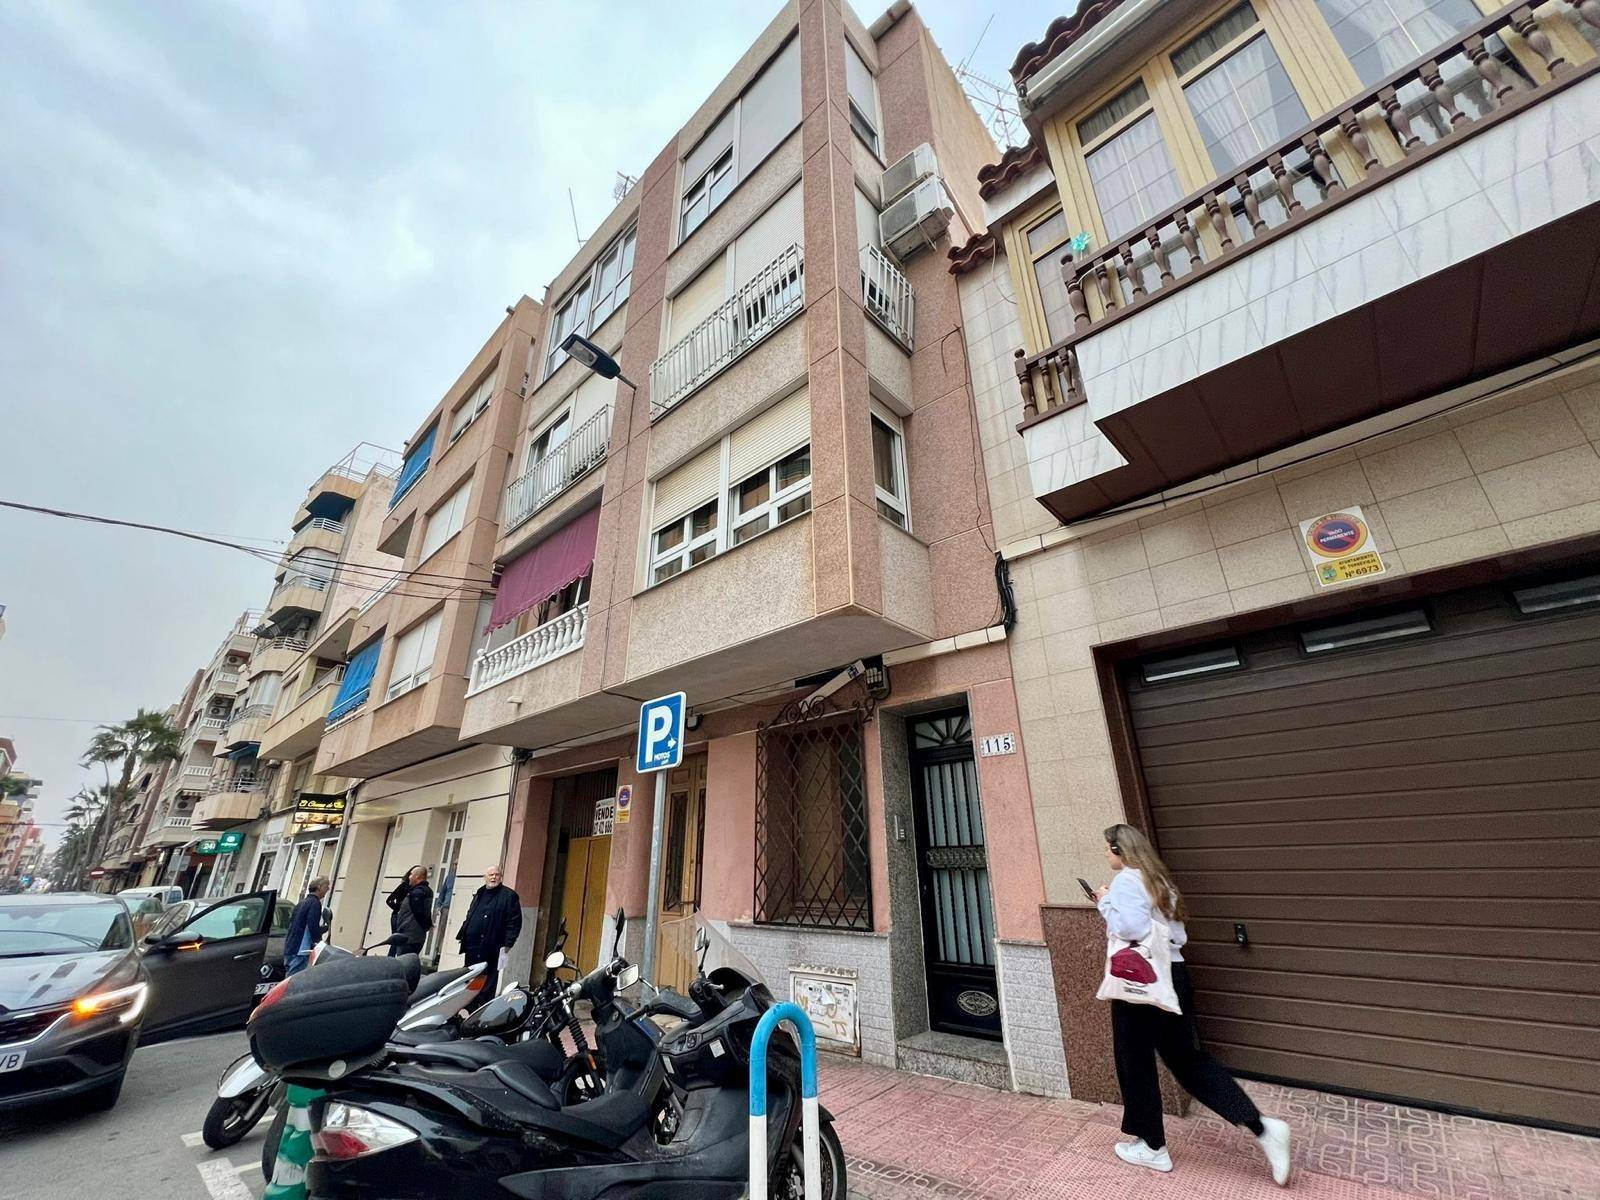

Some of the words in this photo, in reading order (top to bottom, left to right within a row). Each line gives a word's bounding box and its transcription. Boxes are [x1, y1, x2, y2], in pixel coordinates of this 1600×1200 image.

[1320, 530, 1355, 542] PERMANENTE
[645, 706, 672, 763] P
[985, 737, 1011, 753] 115
